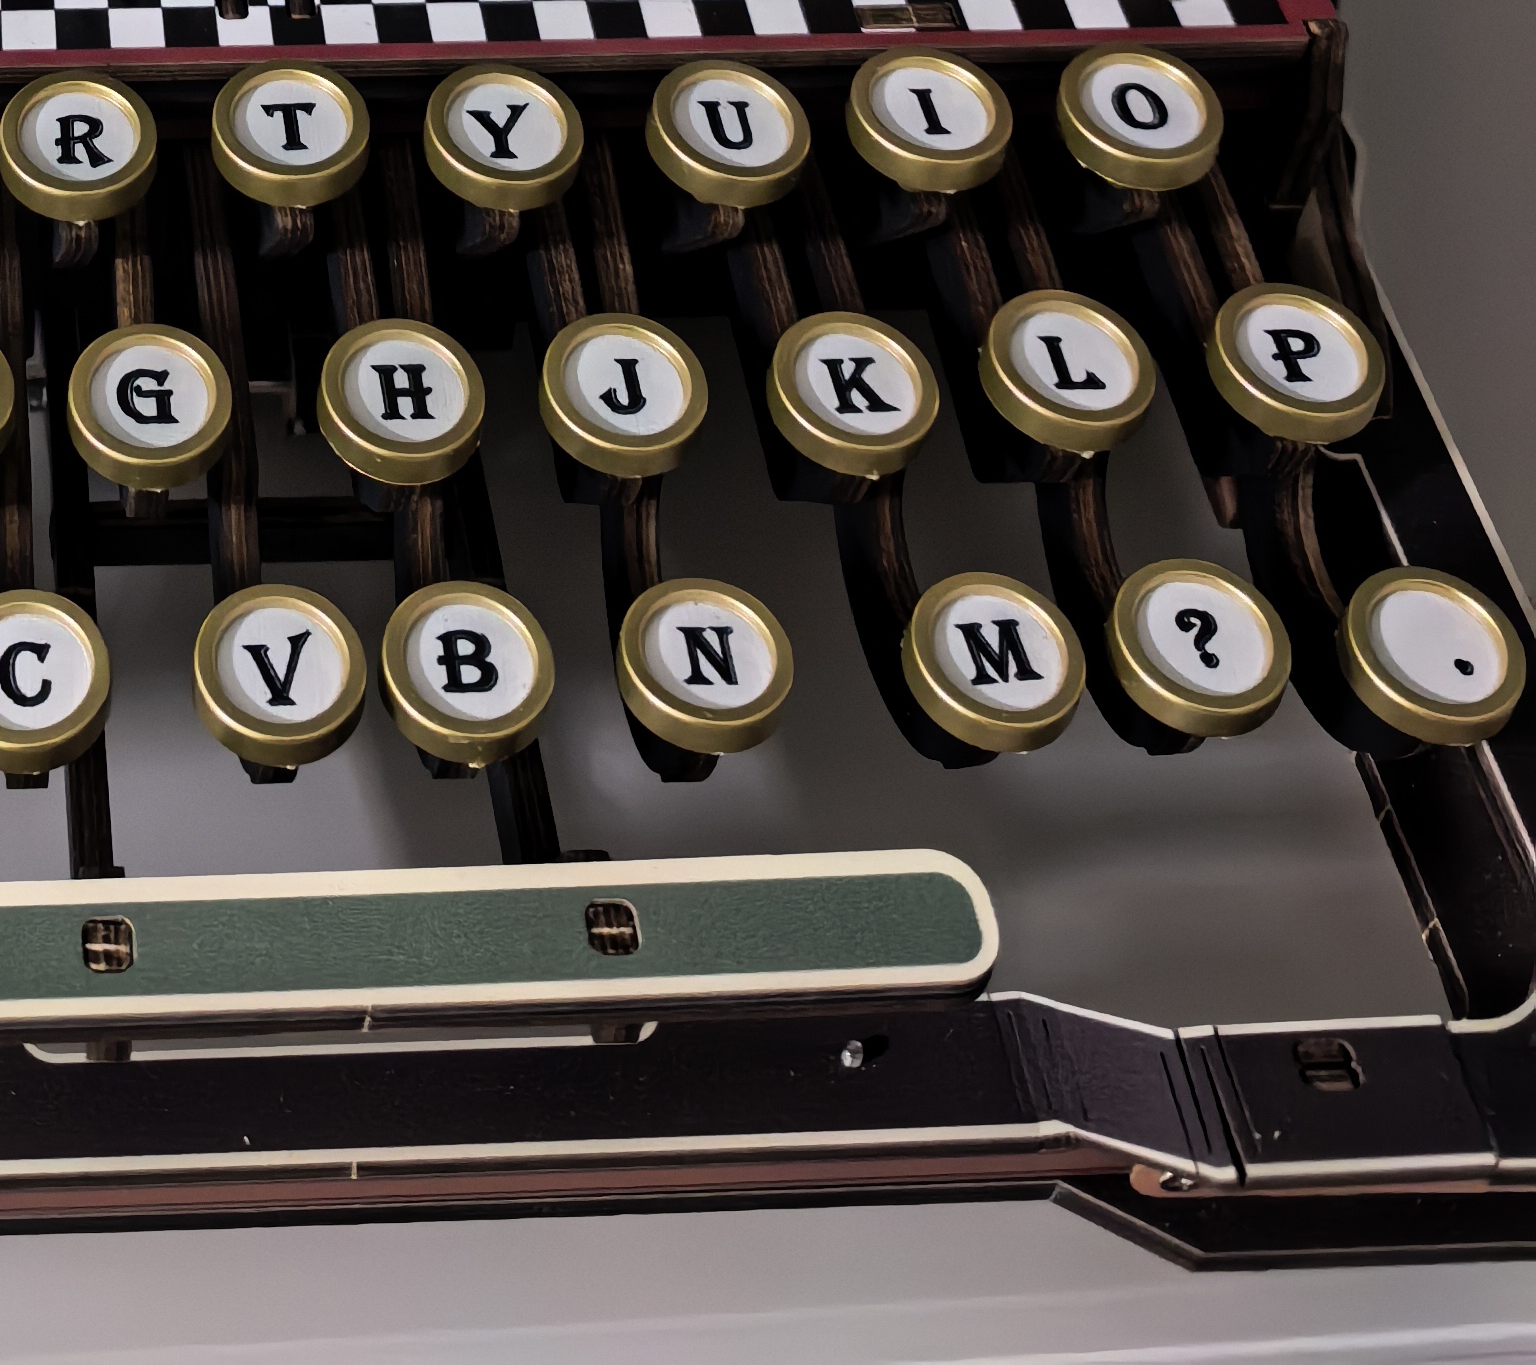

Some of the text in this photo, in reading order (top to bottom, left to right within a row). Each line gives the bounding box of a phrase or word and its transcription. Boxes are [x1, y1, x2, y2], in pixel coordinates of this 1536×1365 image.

[260, 102, 317, 152] T
[467, 102, 529, 159] Y
[697, 100, 754, 151] U
[908, 88, 952, 135] I
[1111, 82, 1169, 131] O
[54, 114, 114, 169] R
[1037, 335, 1107, 391] L
[1262, 328, 1321, 382] P
[116, 368, 180, 425] G
[370, 363, 435, 421] H
[598, 358, 647, 416] J
[819, 356, 901, 415] K
[435, 629, 499, 694] B
[675, 625, 739, 686] N
[954, 618, 1045, 686] M
[1174, 608, 1220, 669] ?
[241, 629, 312, 707] V
